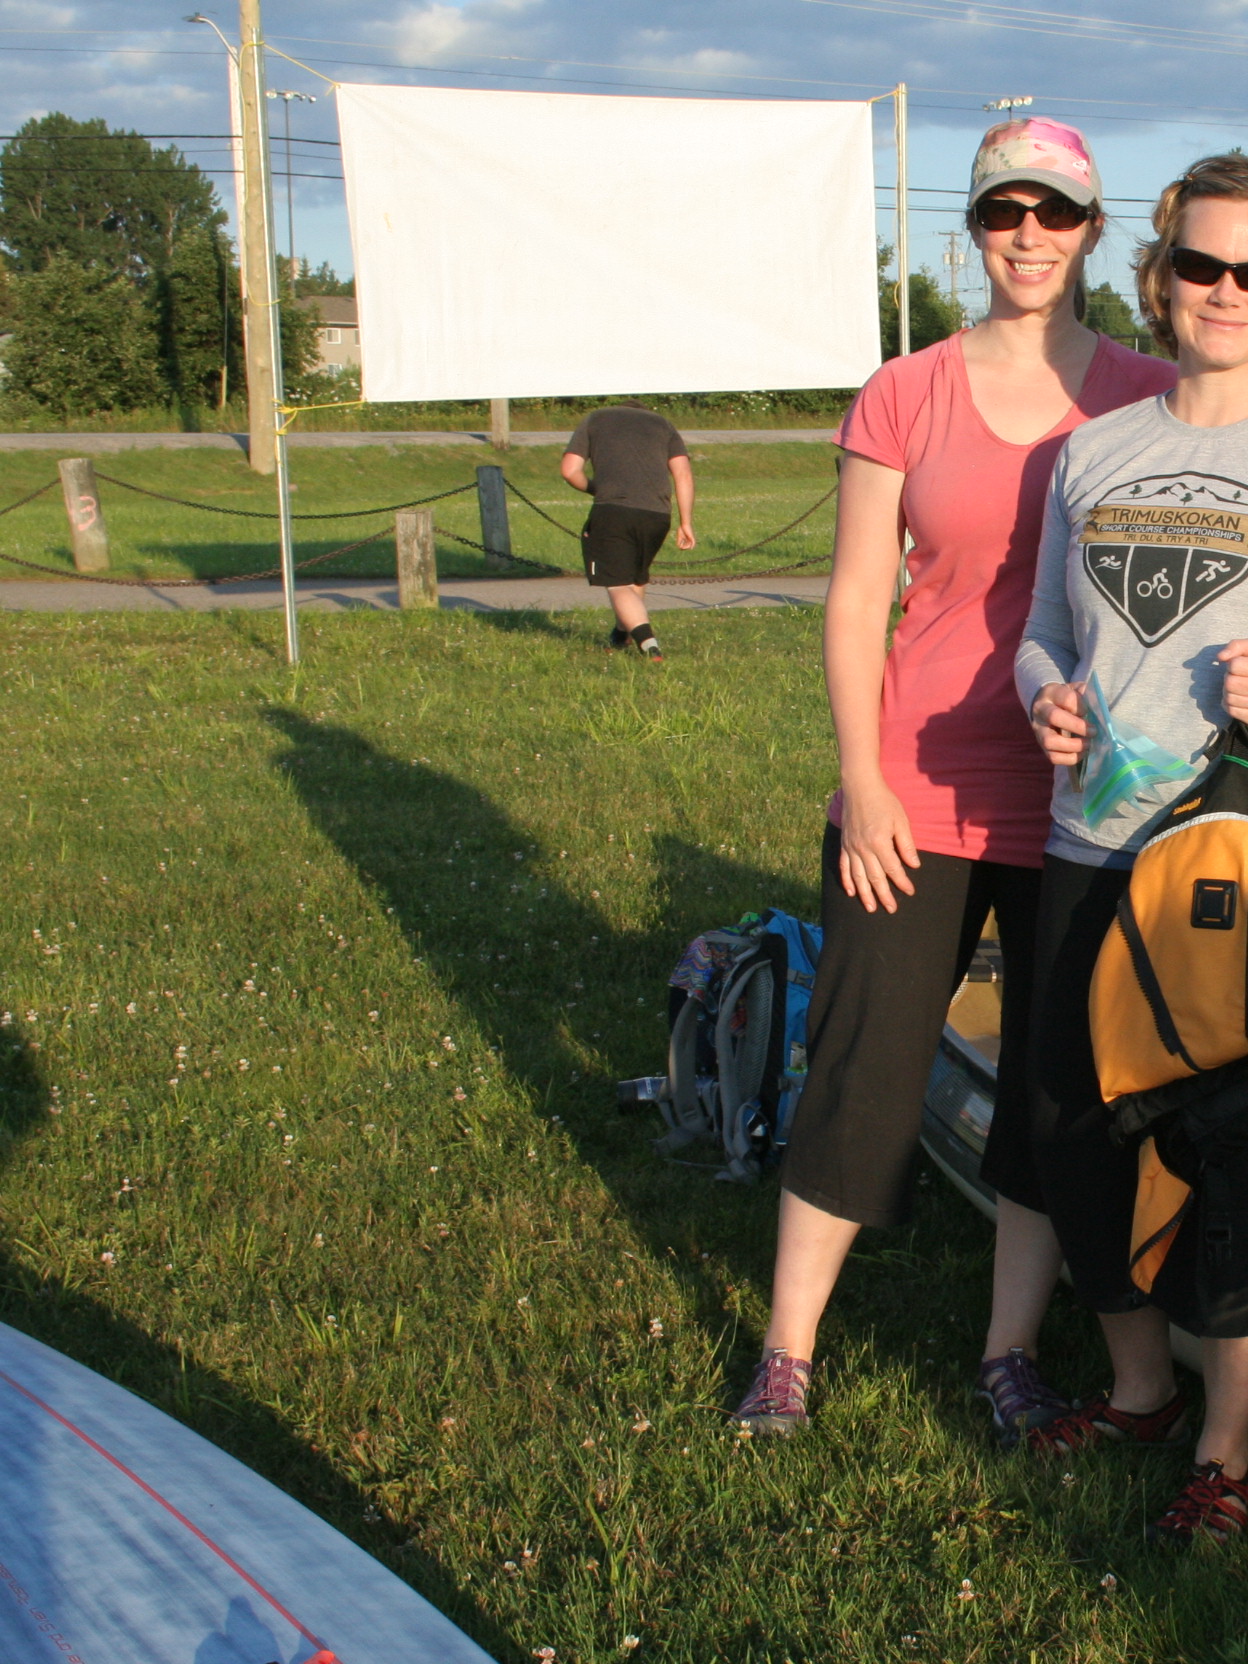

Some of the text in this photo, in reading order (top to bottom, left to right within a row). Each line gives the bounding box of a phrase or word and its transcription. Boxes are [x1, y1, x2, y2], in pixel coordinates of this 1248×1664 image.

[1111, 508, 1241, 530] TRIMUSKOKAN
[1100, 524, 1242, 542] SHORT COURSE CHAMPIONSHIPS
[1156, 535, 1162, 543] &
[1166, 535, 1184, 543] TRY
[1194, 537, 1209, 545] TRI
